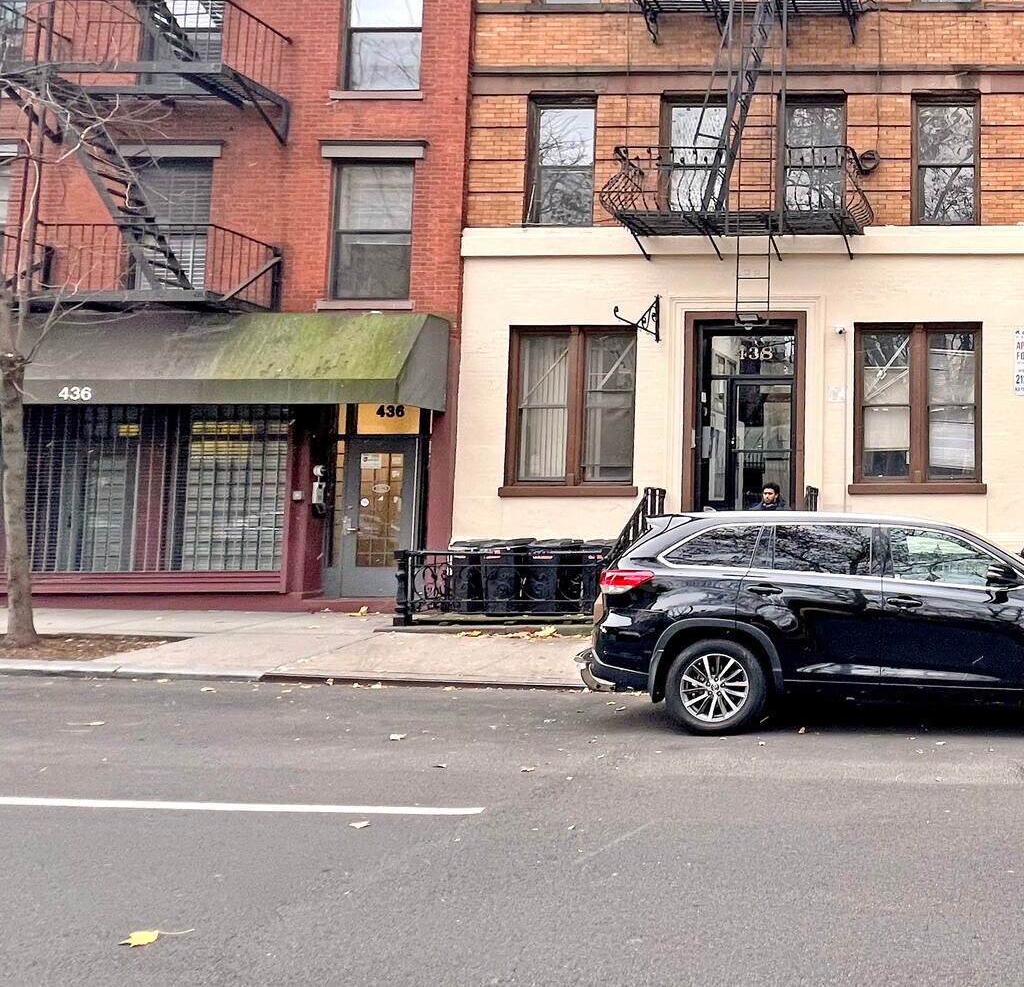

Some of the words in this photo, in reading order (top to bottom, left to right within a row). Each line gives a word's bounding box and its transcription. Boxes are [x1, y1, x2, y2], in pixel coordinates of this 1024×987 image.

[735, 345, 773, 360] 438
[58, 386, 92, 401] 436
[376, 405, 405, 418] 436
